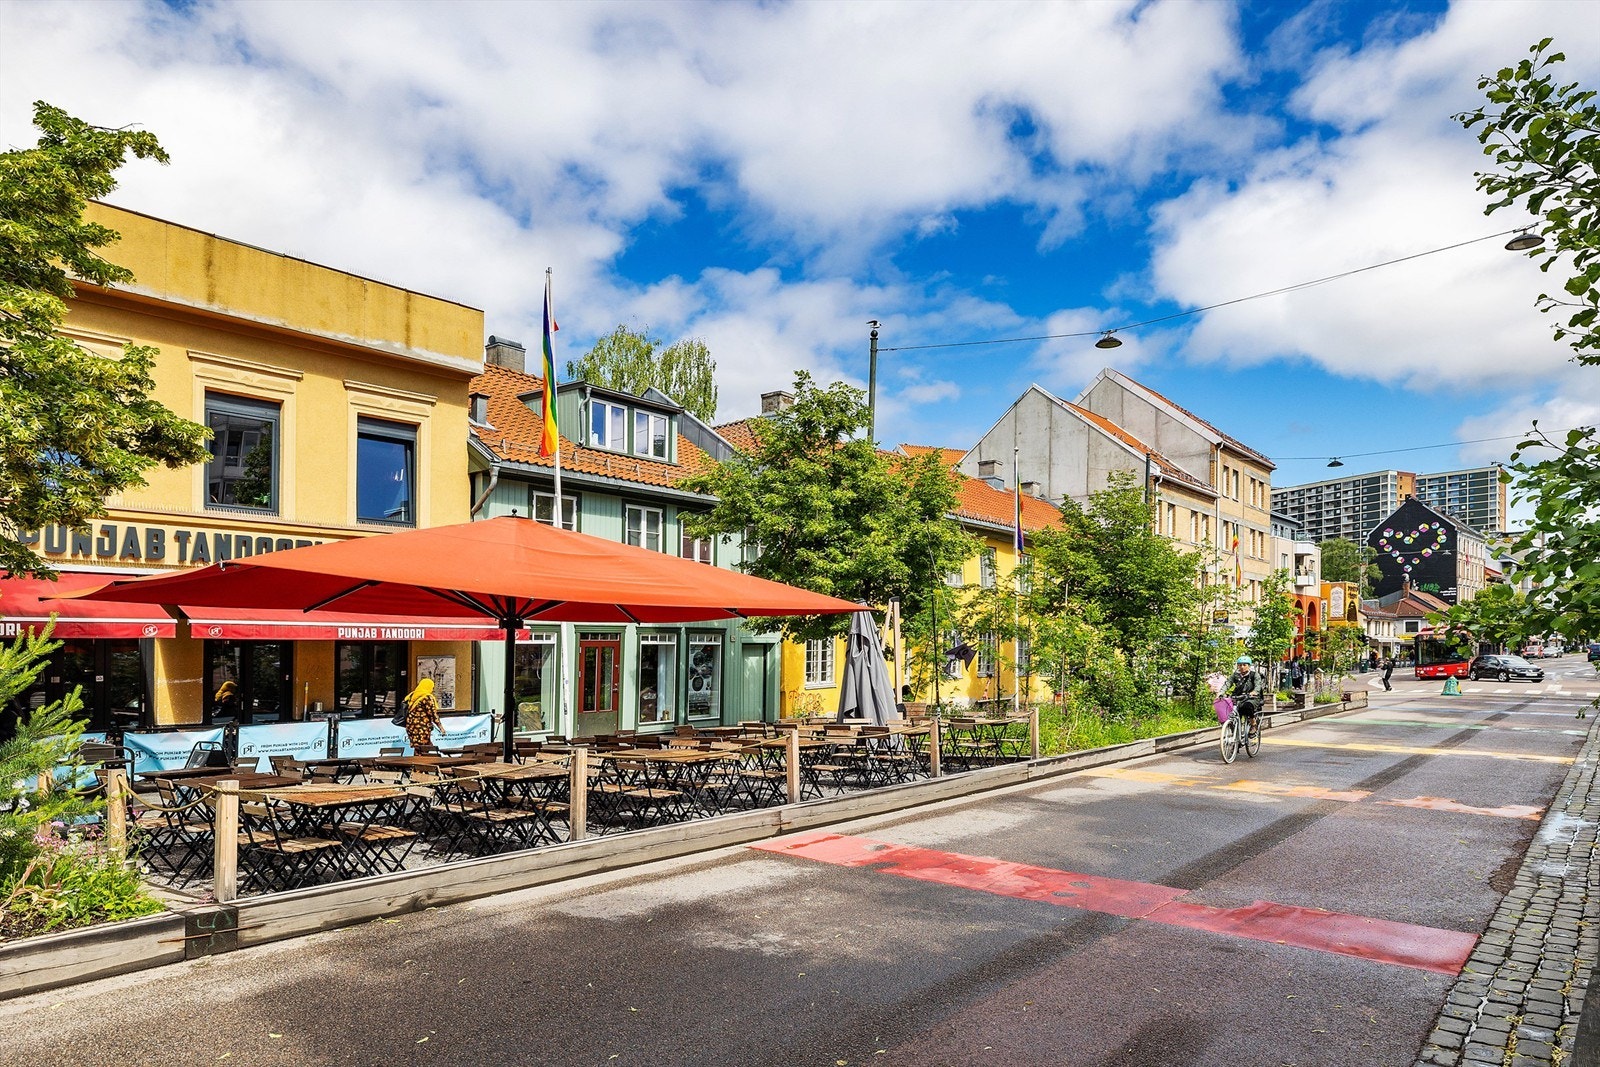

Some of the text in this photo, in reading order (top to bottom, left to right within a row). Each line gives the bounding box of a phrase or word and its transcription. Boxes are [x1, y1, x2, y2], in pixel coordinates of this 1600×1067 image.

[174, 530, 323, 563] TANDO
[338, 627, 425, 639] PUNJAB TANDOORI
